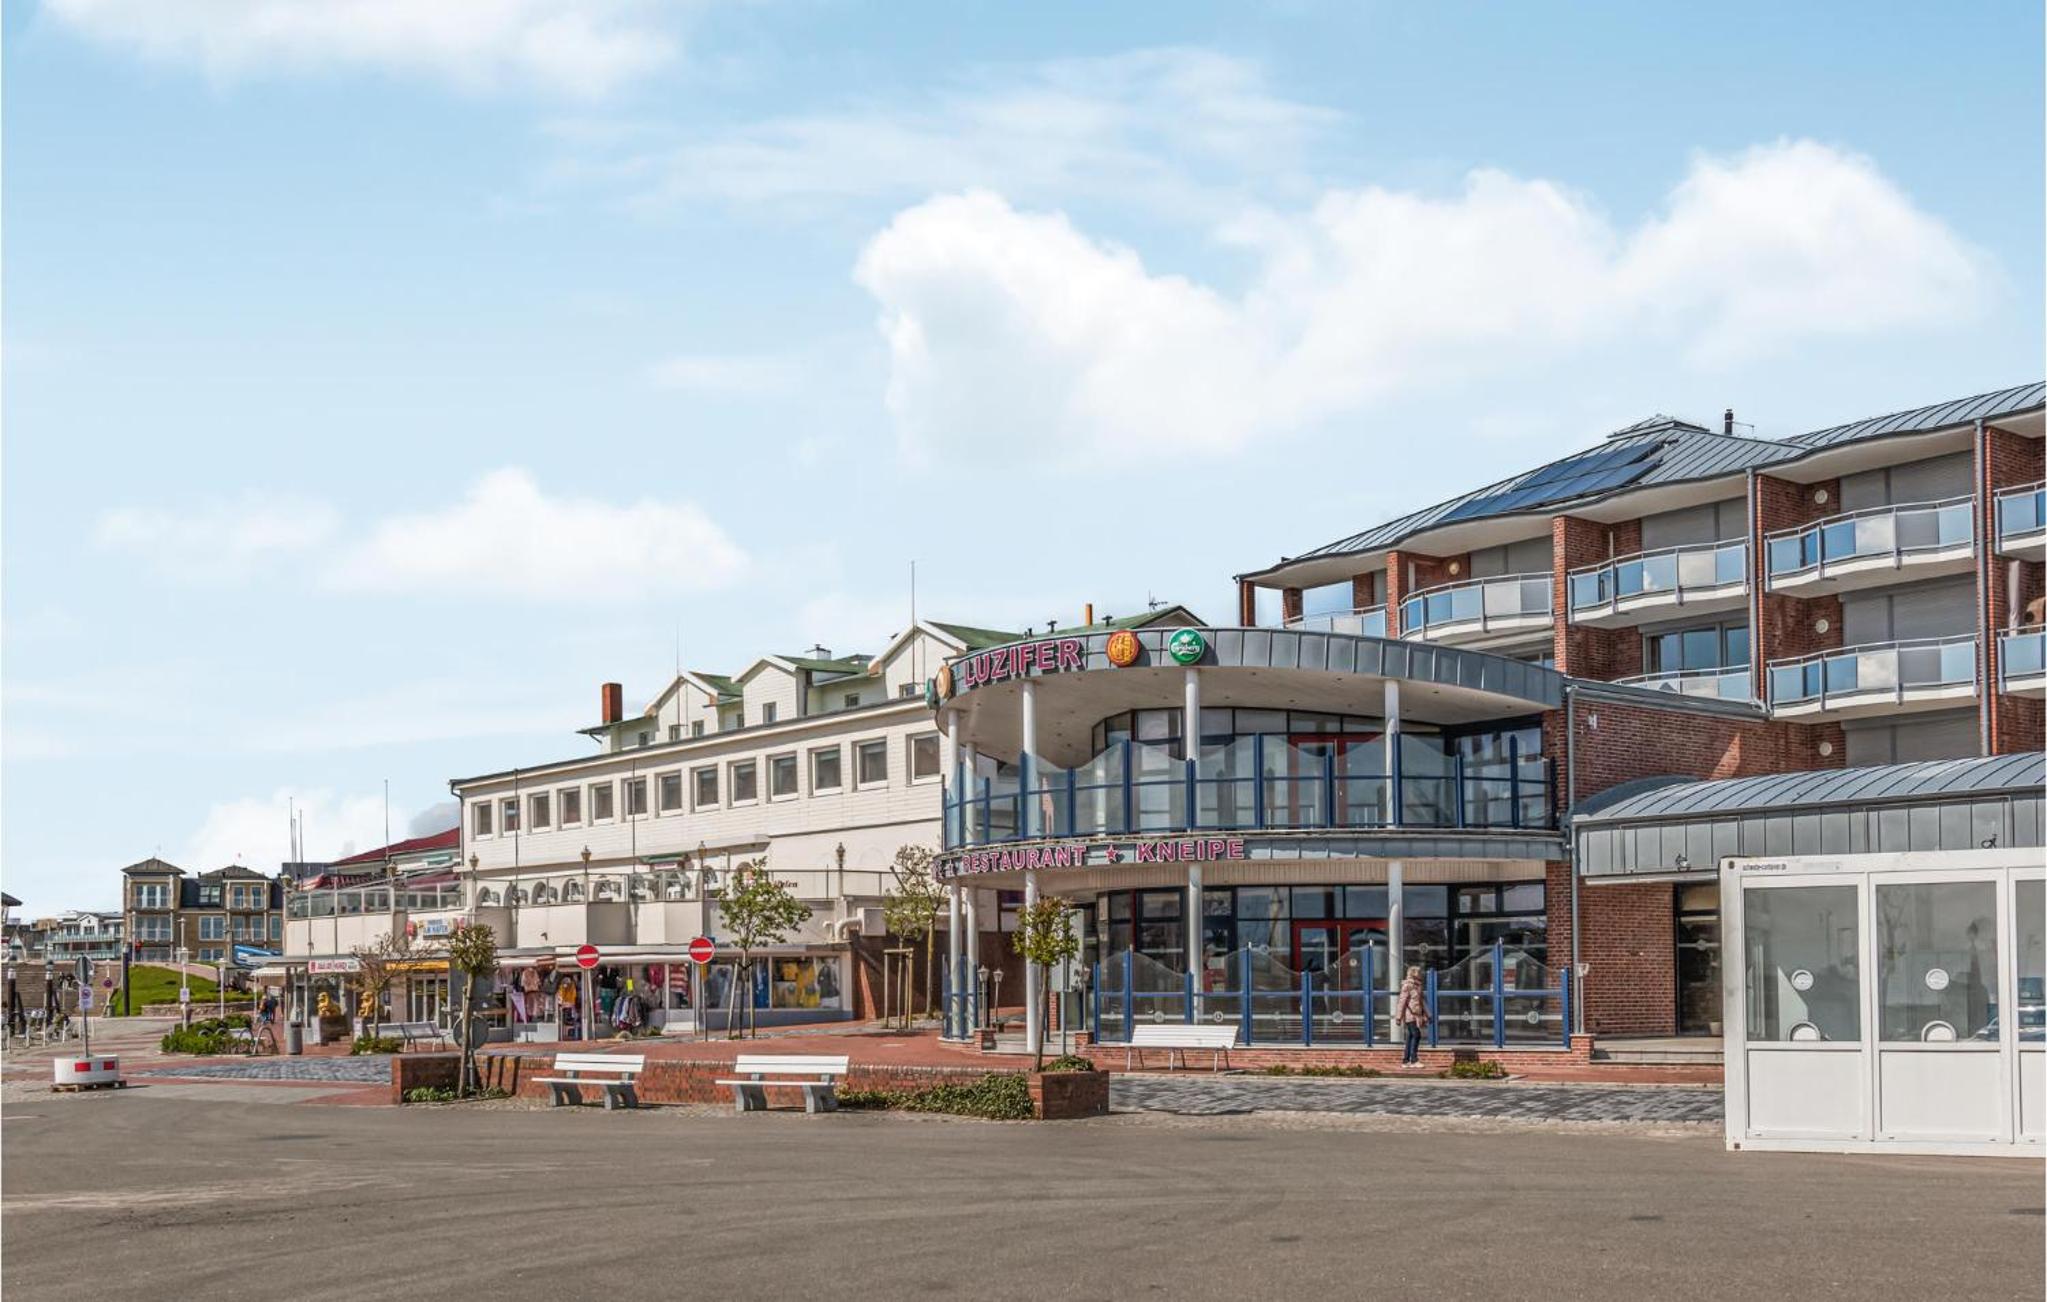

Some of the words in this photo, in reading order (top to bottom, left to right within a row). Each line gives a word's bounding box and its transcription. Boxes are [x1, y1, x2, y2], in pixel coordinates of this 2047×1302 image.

[963, 638, 1081, 687] LUZIFER
[961, 845, 1087, 873] RESTAURANT
[1136, 839, 1245, 863] KNEIPE
